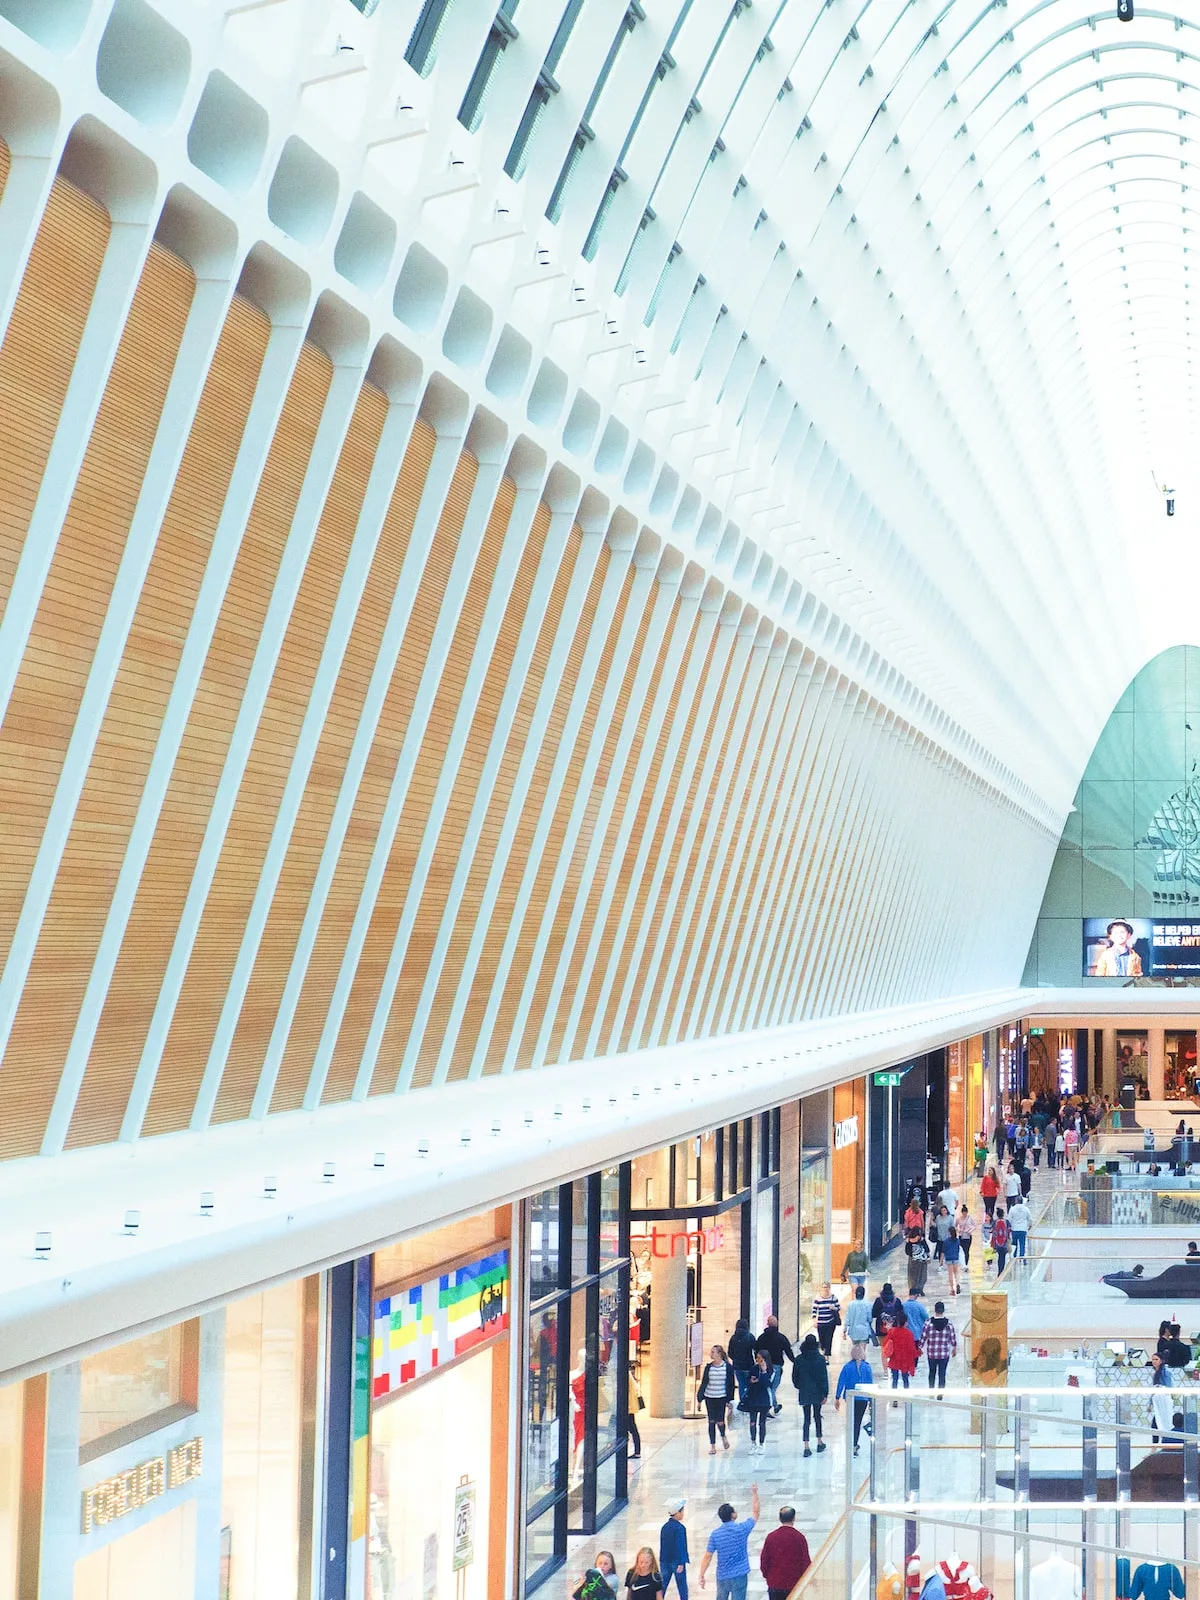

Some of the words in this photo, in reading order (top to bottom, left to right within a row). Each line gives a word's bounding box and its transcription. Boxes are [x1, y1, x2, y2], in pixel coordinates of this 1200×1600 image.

[1153, 925, 1165, 936] WE
[1165, 925, 1191, 936] HELPED
[1153, 936, 1181, 947] BELIEVE
[1160, 1194, 1173, 1209] TOP
[80, 1456, 165, 1534] FOREVER
